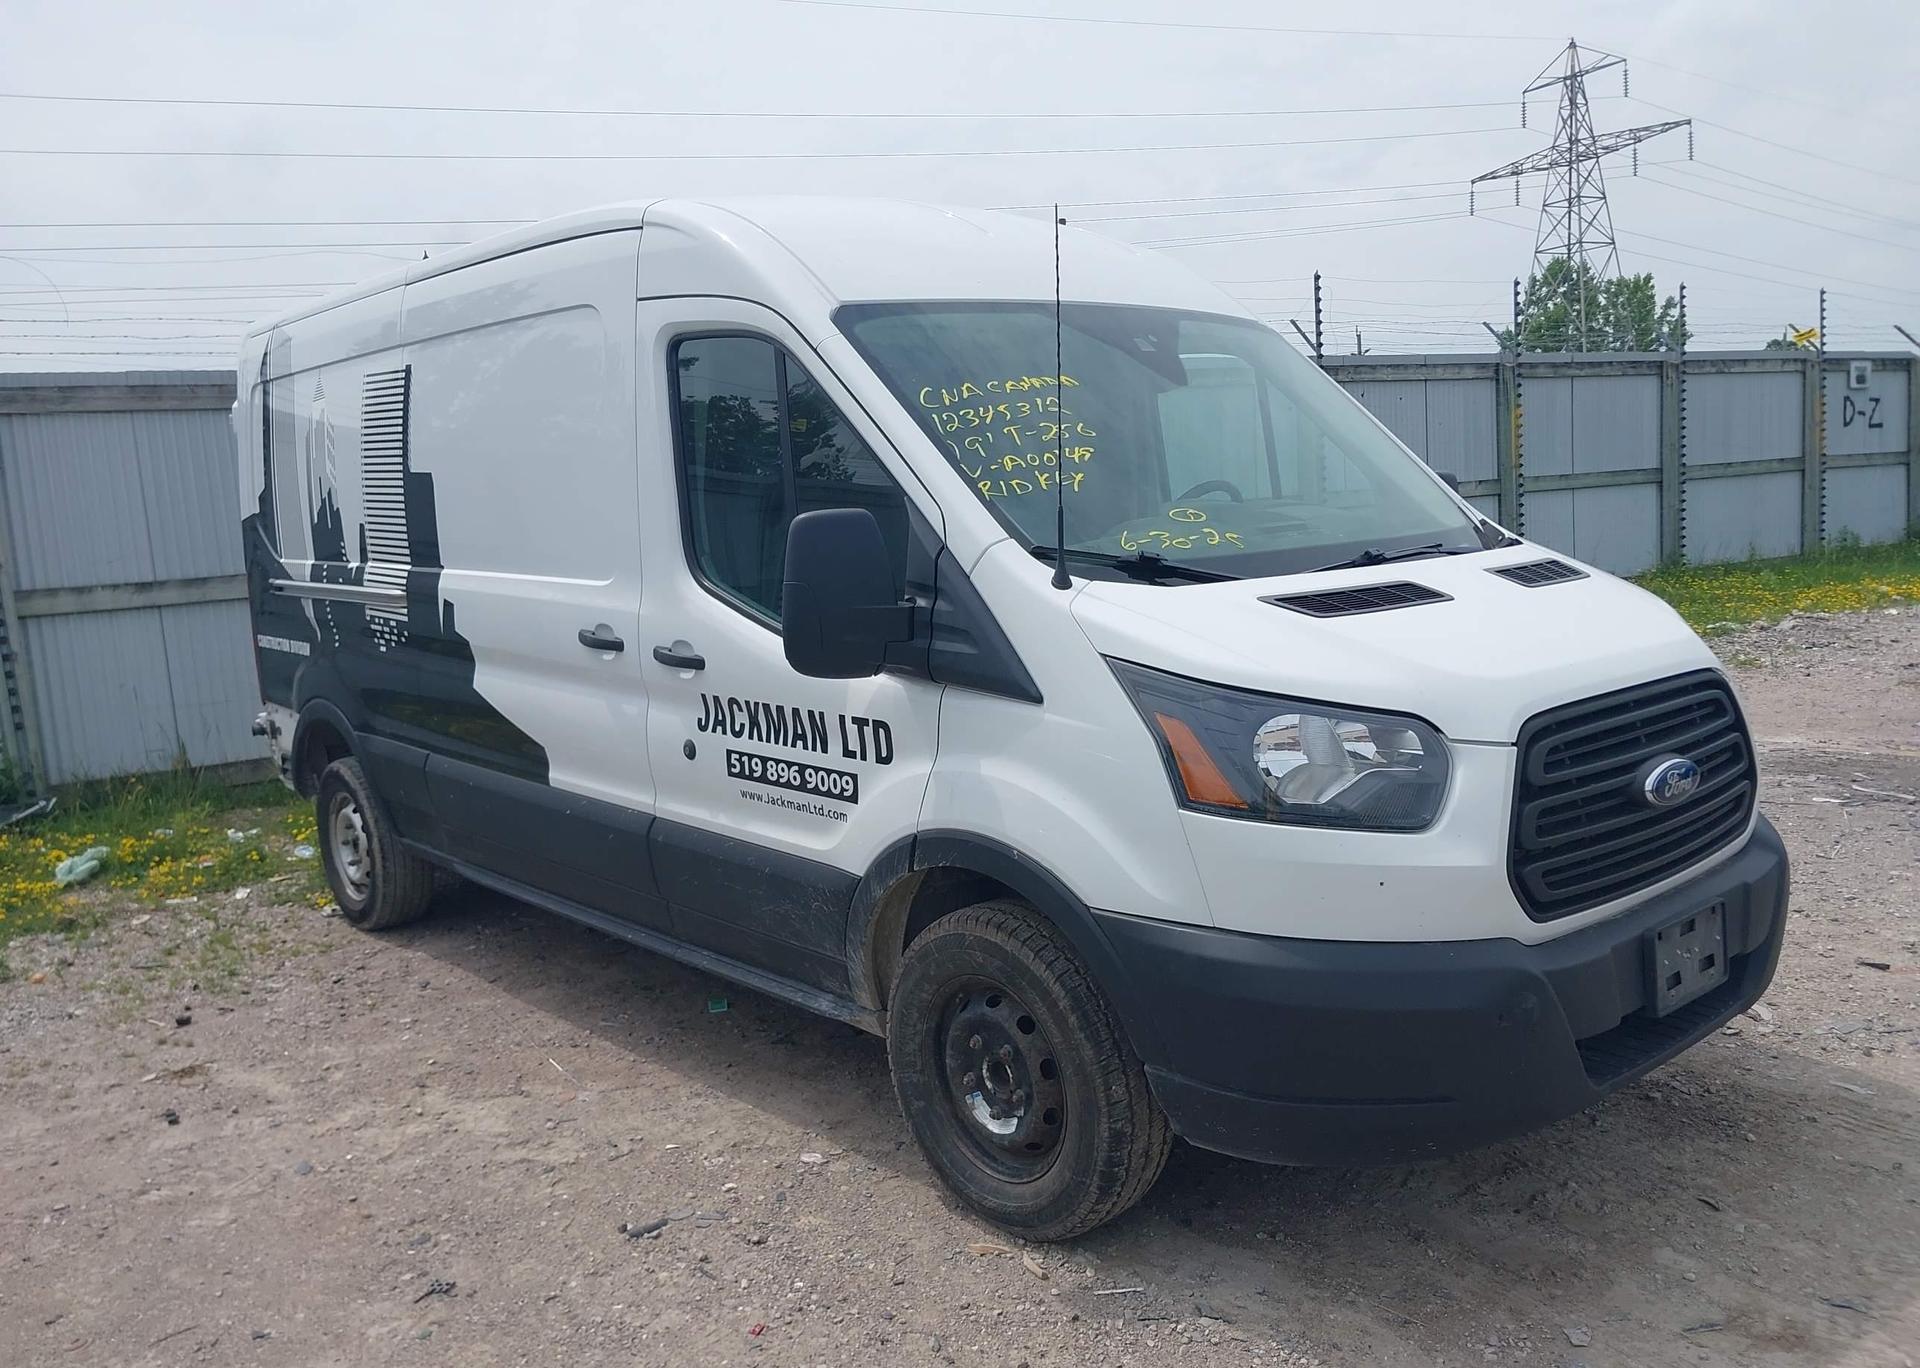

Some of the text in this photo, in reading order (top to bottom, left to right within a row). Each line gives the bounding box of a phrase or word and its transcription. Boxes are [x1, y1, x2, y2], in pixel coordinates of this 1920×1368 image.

[920, 382, 984, 408] CNA
[1843, 395, 1884, 428] D-Z
[697, 693, 894, 766] JACKMAN LTD
[730, 753, 854, 797] 519 896 9009
[1664, 767, 1694, 798] Ford
[739, 788, 848, 823] www.JackmanLtd.com
